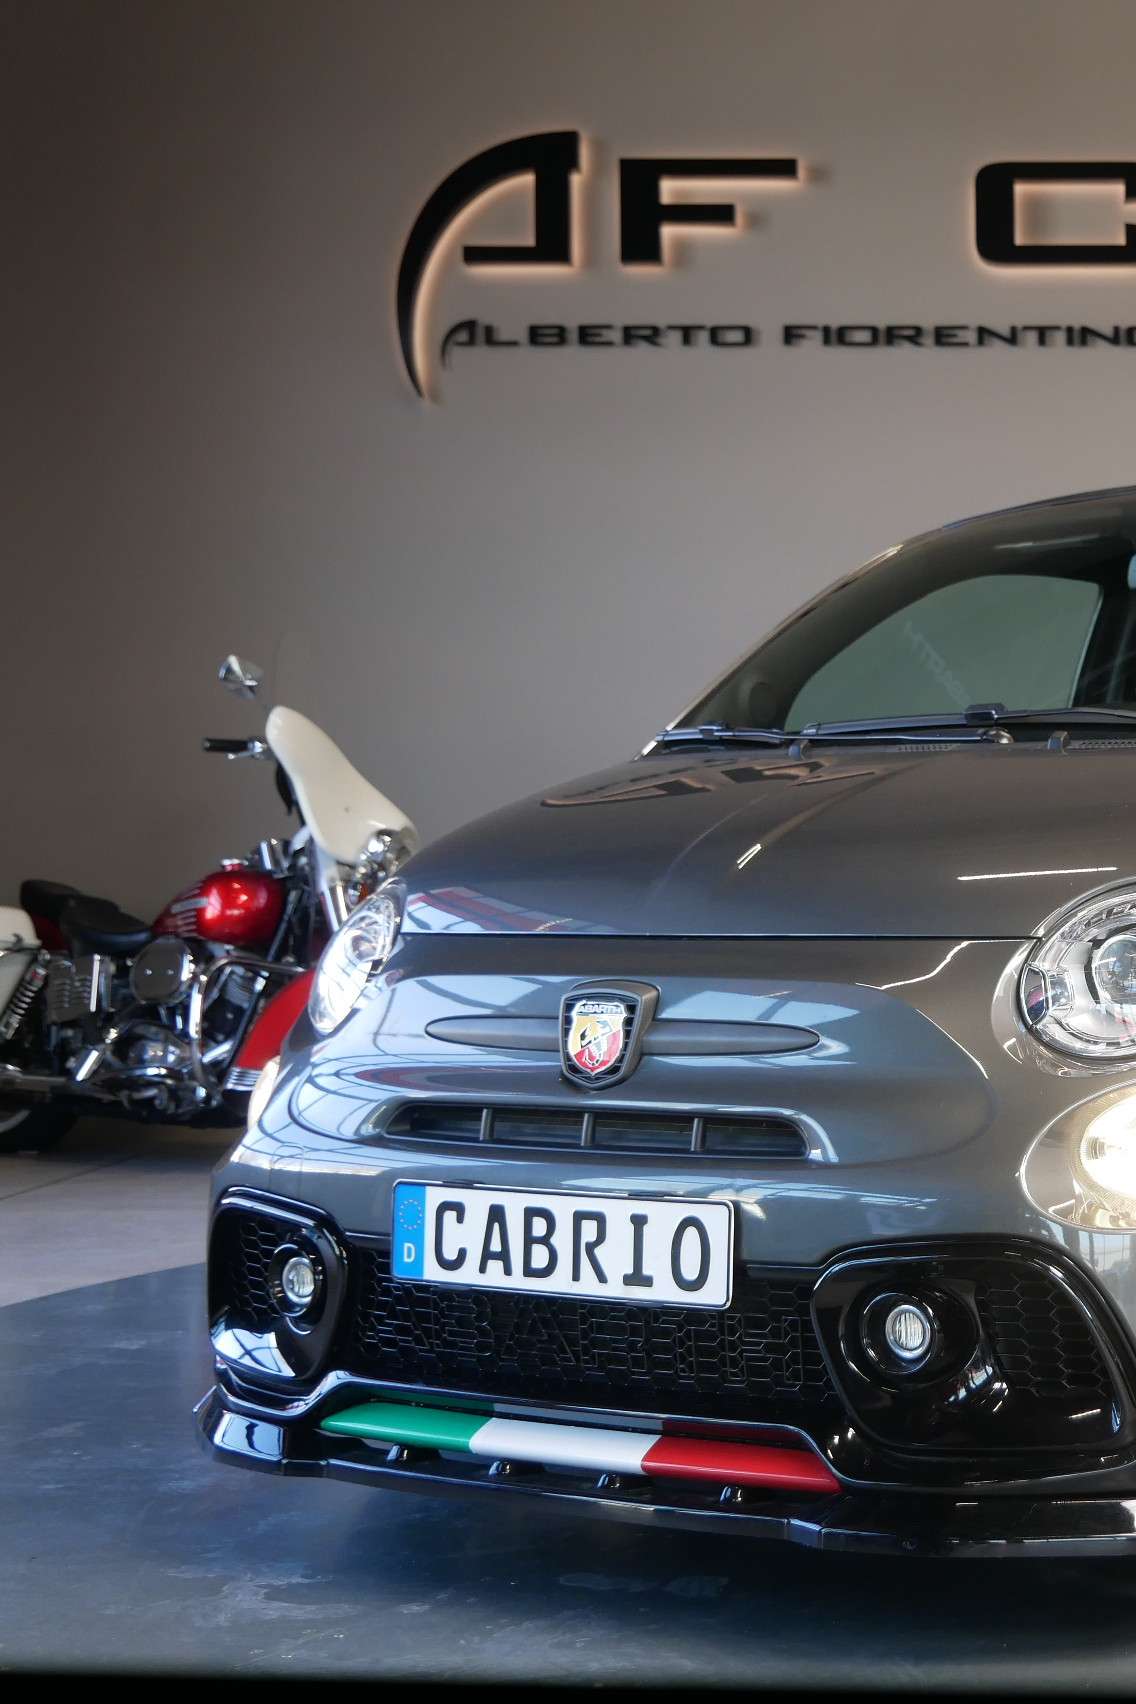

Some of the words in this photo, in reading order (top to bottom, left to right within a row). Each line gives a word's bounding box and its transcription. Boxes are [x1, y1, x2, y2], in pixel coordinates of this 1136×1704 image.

[396, 131, 799, 399] AF
[441, 319, 753, 370] ALBERTO
[403, 1242, 416, 1263] D
[434, 1200, 711, 1291] CABRIO
